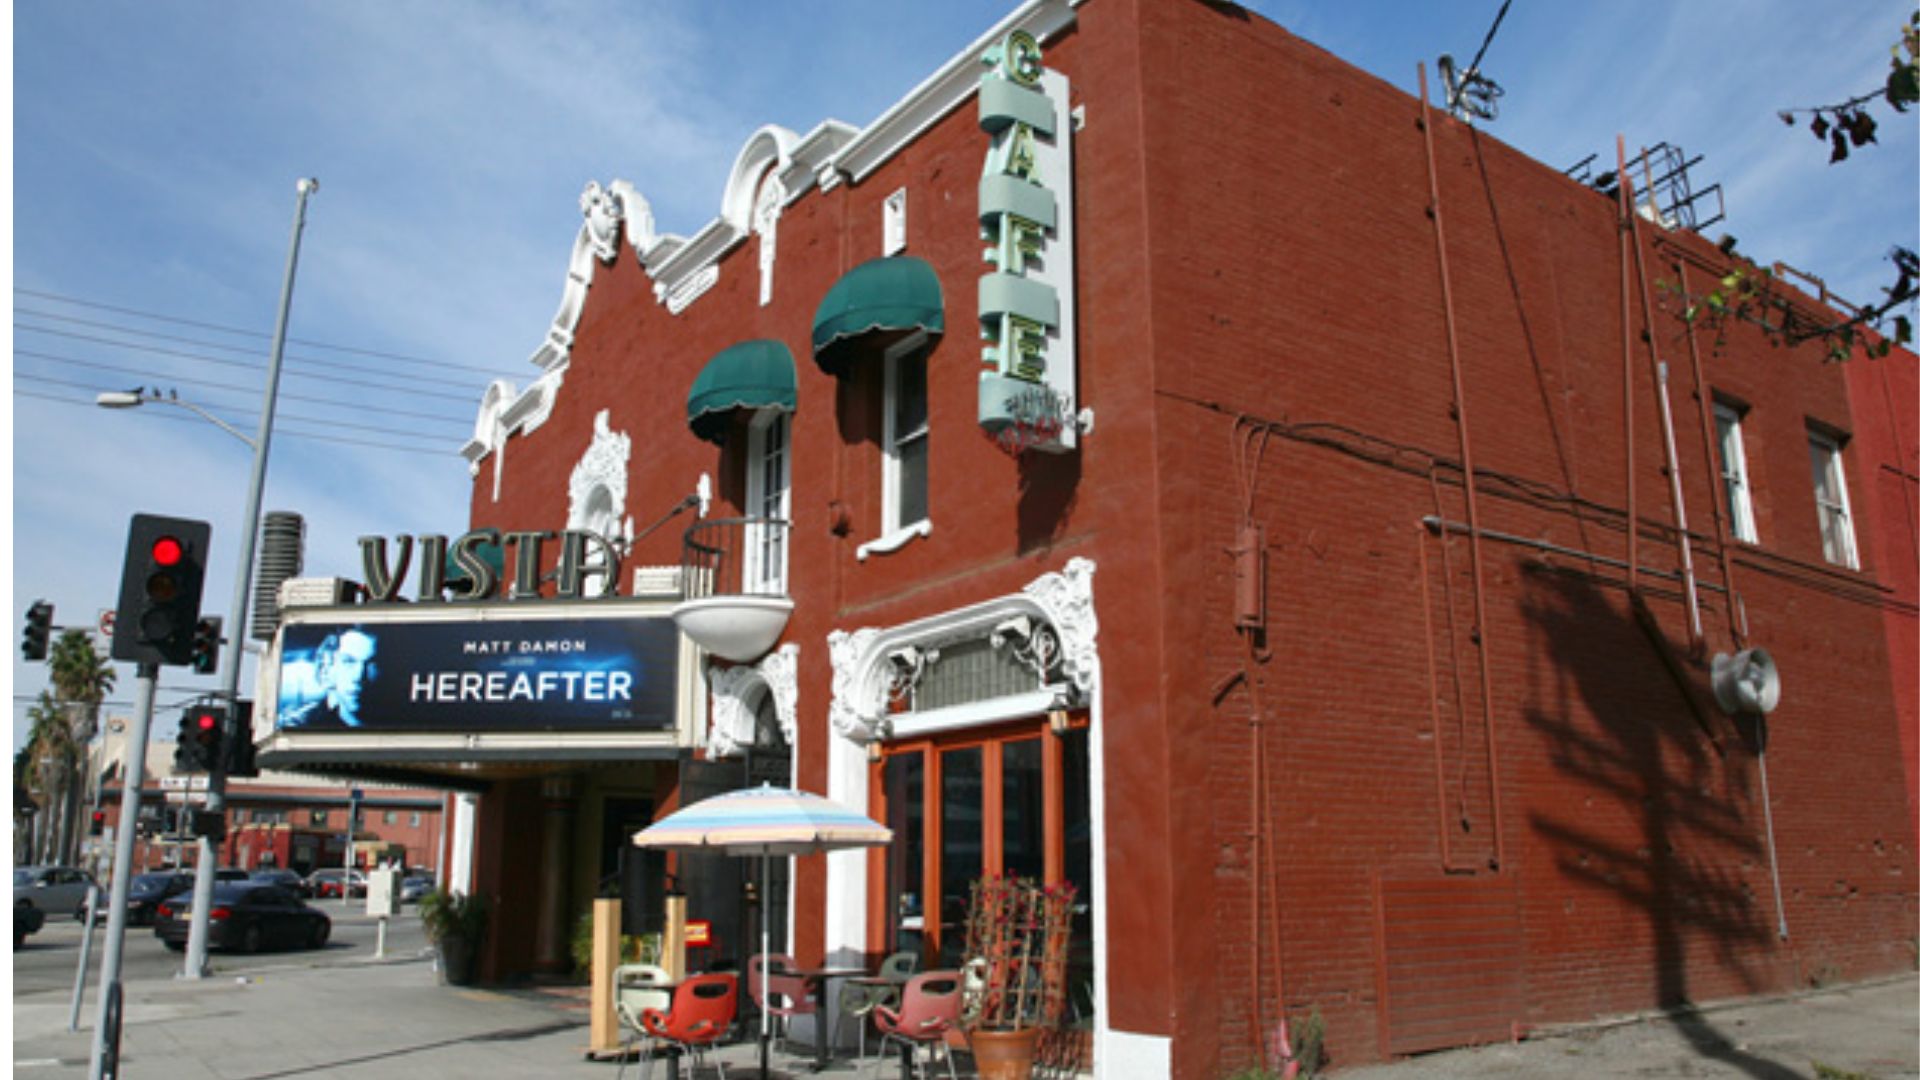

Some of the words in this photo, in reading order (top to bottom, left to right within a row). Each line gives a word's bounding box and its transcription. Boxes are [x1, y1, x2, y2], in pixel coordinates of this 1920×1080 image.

[1000, 28, 1046, 385] CAFE
[358, 528, 621, 600] VISTA
[463, 640, 512, 653] MATT
[519, 639, 587, 652] DAMON
[410, 671, 633, 702] HEREAFTER
